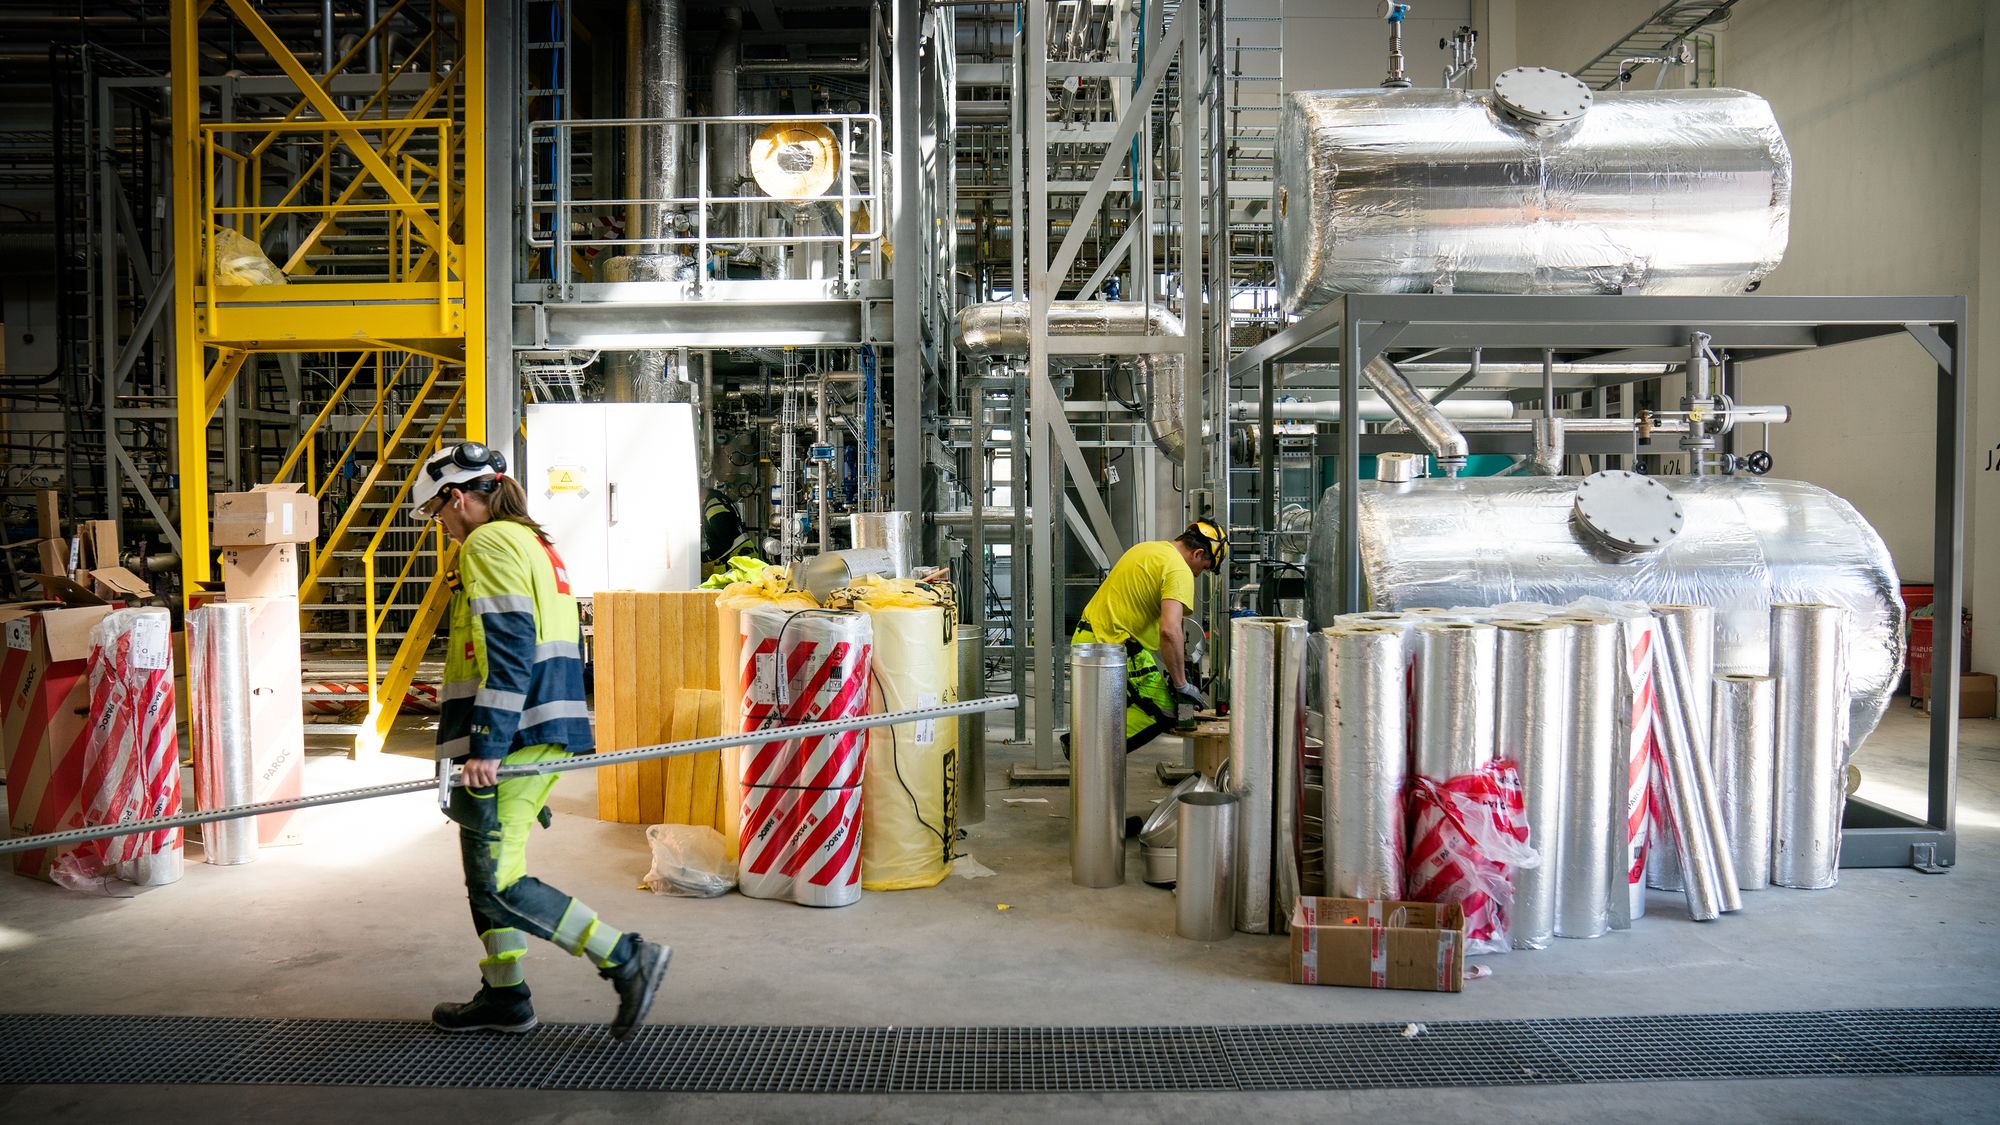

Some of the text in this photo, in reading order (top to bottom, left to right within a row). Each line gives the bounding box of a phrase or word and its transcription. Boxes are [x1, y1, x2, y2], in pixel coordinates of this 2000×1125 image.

[22, 663, 37, 697] PAROC
[99, 703, 115, 730] PAROC
[262, 748, 291, 781] PAROC
[757, 817, 775, 841] PAROC
[791, 823, 808, 846] PAROC
[824, 826, 845, 852] PAROC
